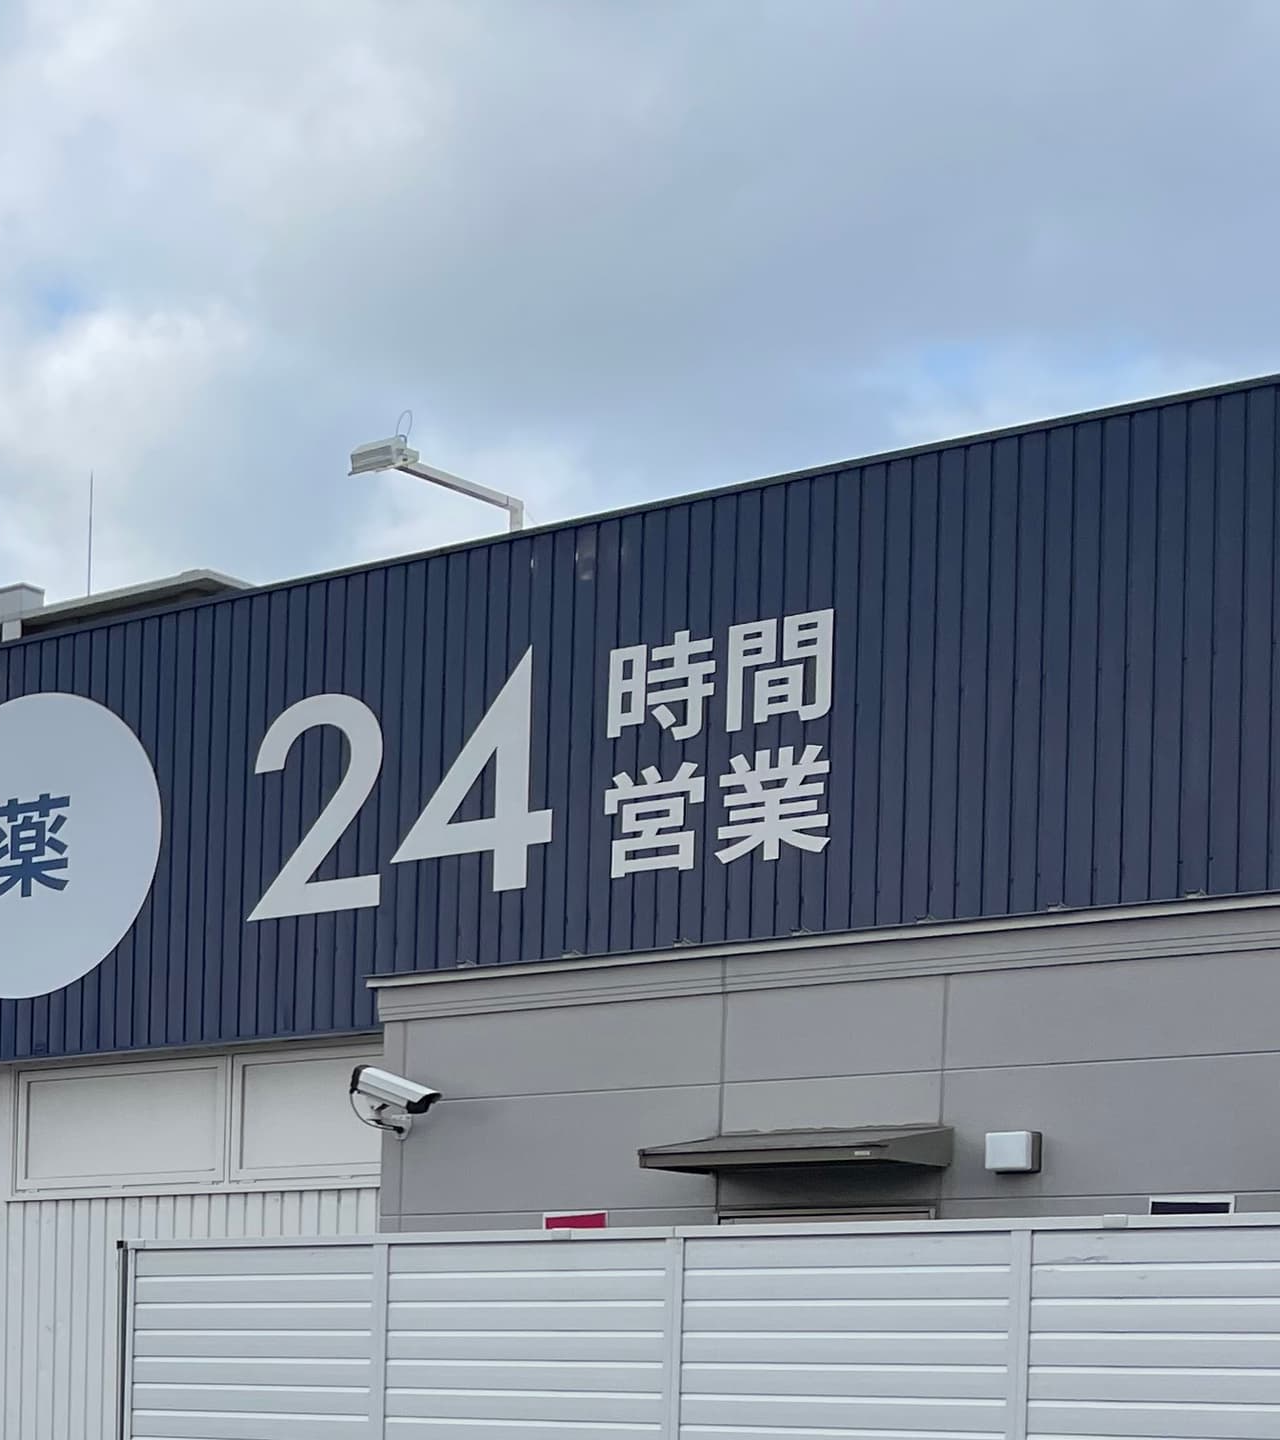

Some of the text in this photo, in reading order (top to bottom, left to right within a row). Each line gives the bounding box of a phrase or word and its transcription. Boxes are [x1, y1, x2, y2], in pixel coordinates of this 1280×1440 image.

[606, 607, 835, 741] 時間
[246, 644, 553, 923] 24
[603, 743, 832, 879] 営業
